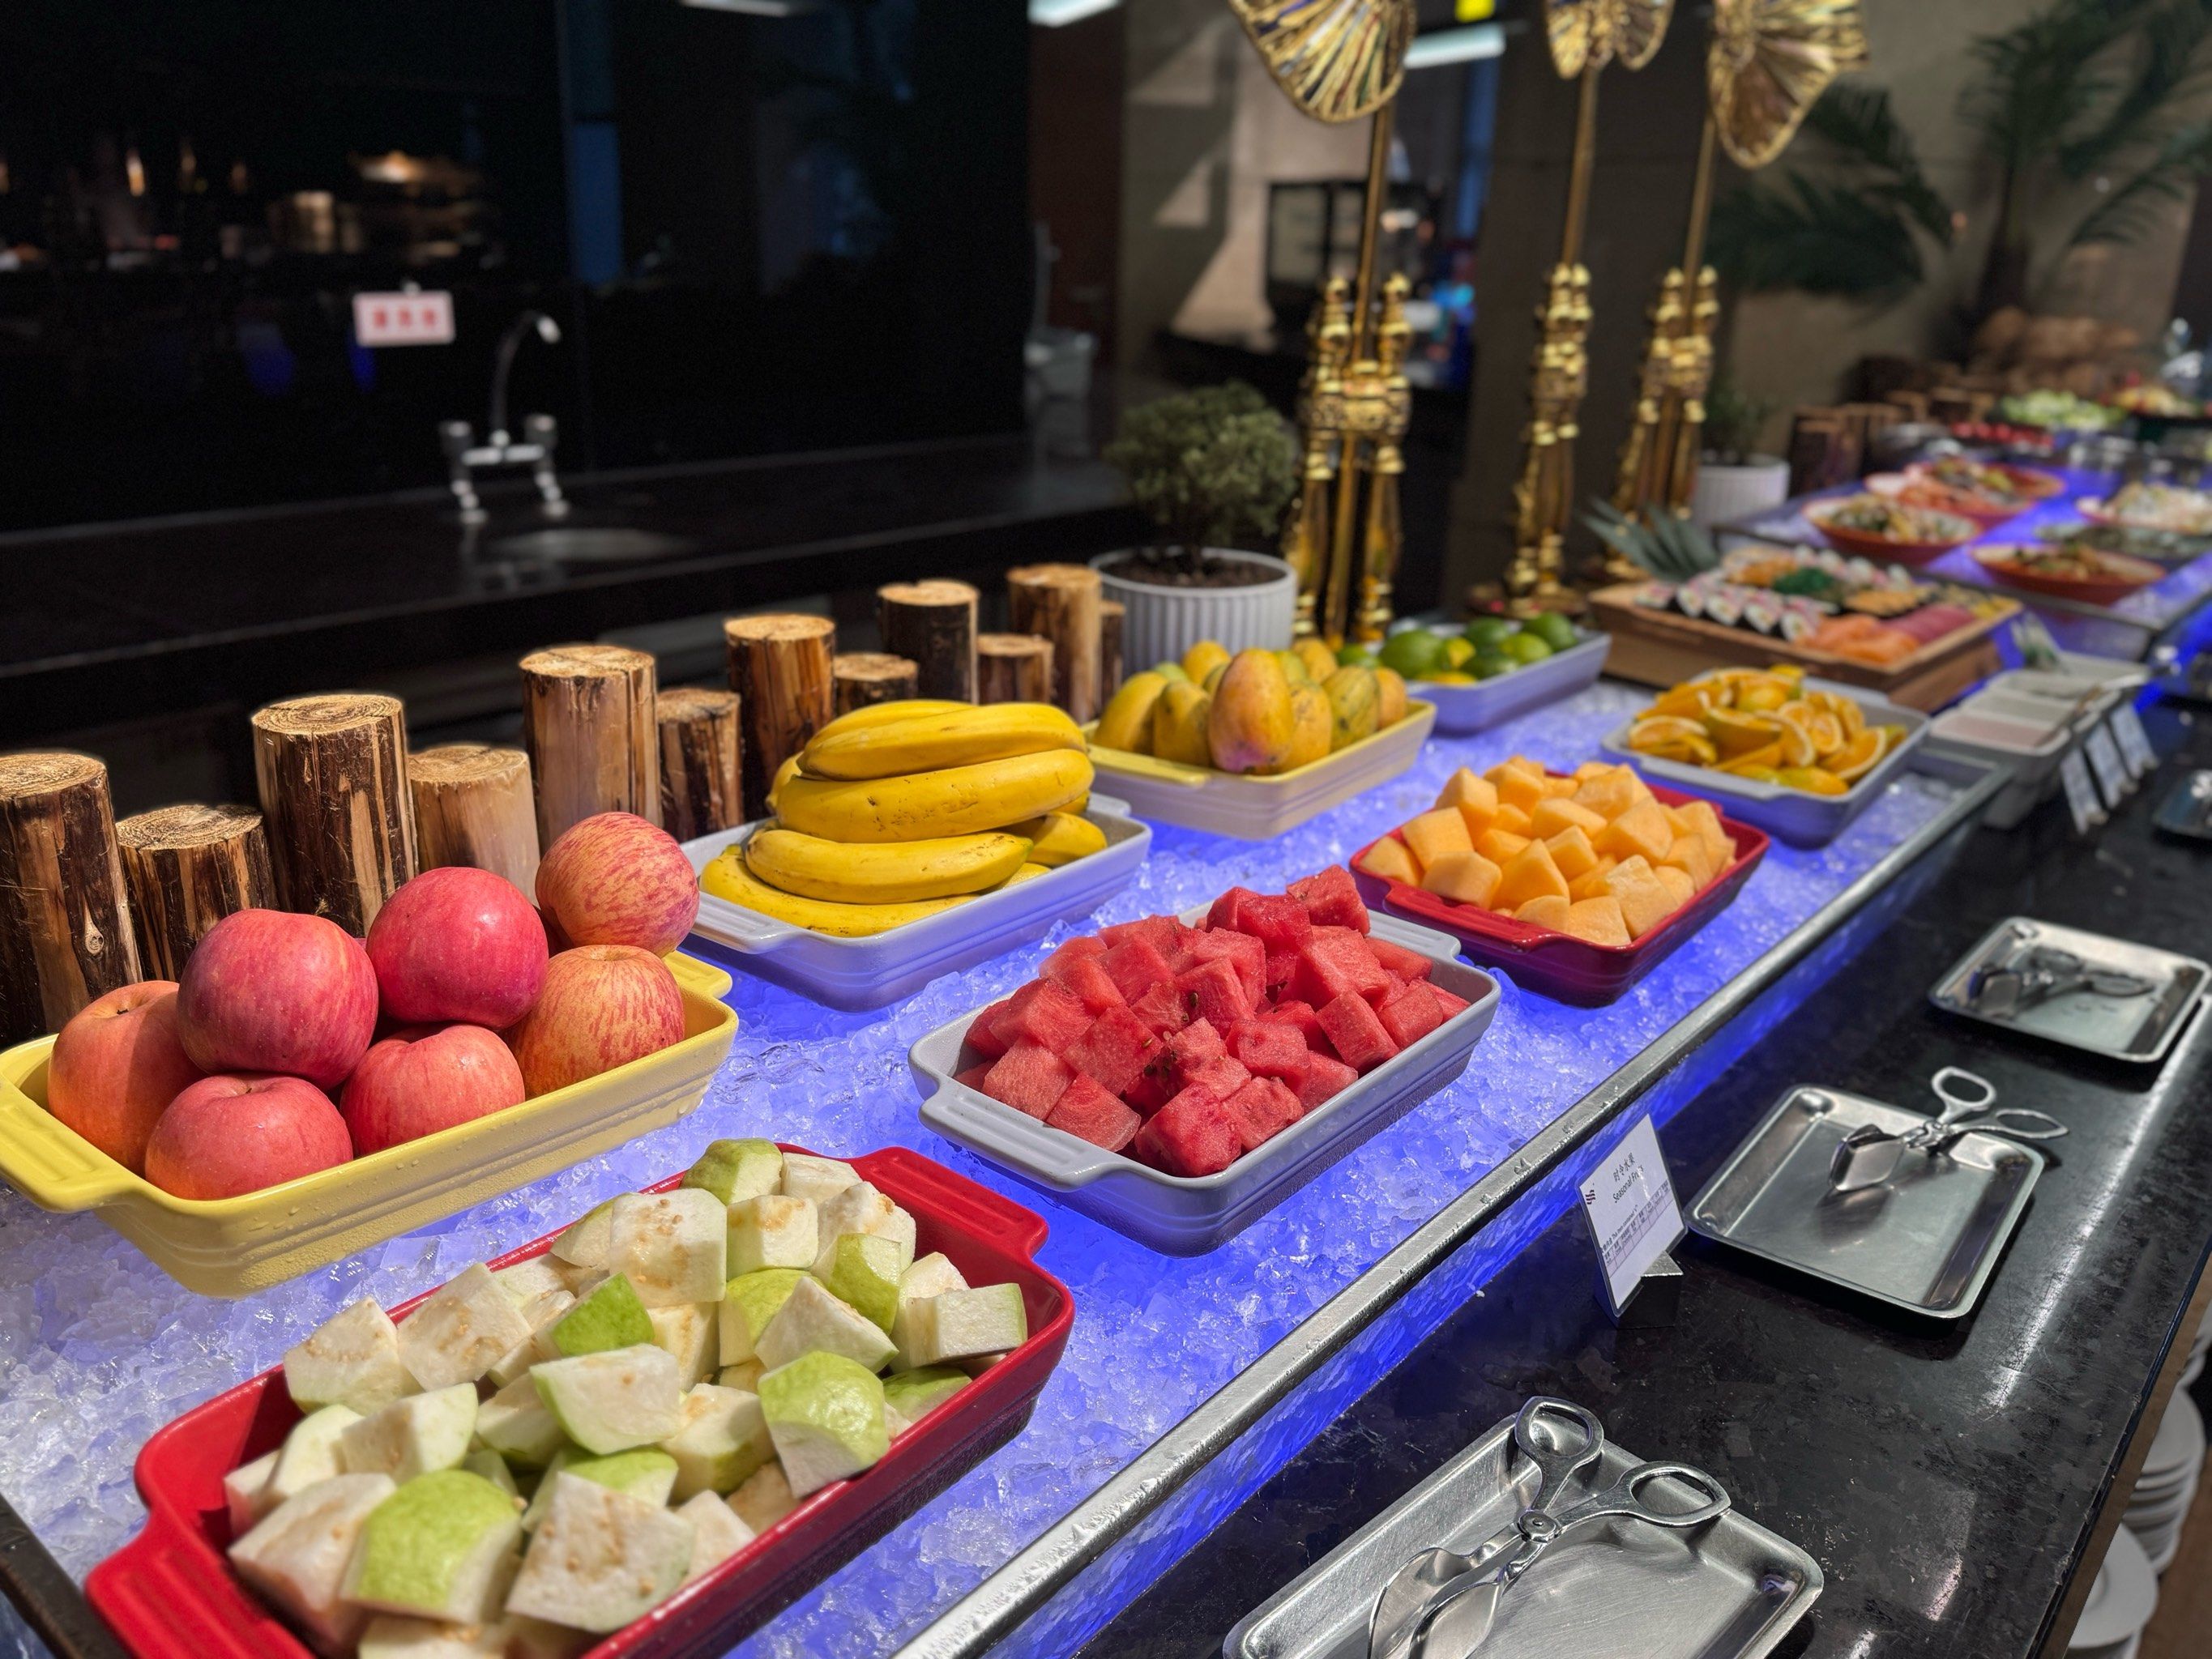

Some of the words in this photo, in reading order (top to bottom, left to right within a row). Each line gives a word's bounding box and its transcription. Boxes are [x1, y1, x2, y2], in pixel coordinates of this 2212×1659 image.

[1613, 1152, 1635, 1183] 时令水果
[1613, 1175, 1632, 1204] Seasonal
[1631, 1164, 1644, 1182] Frus
